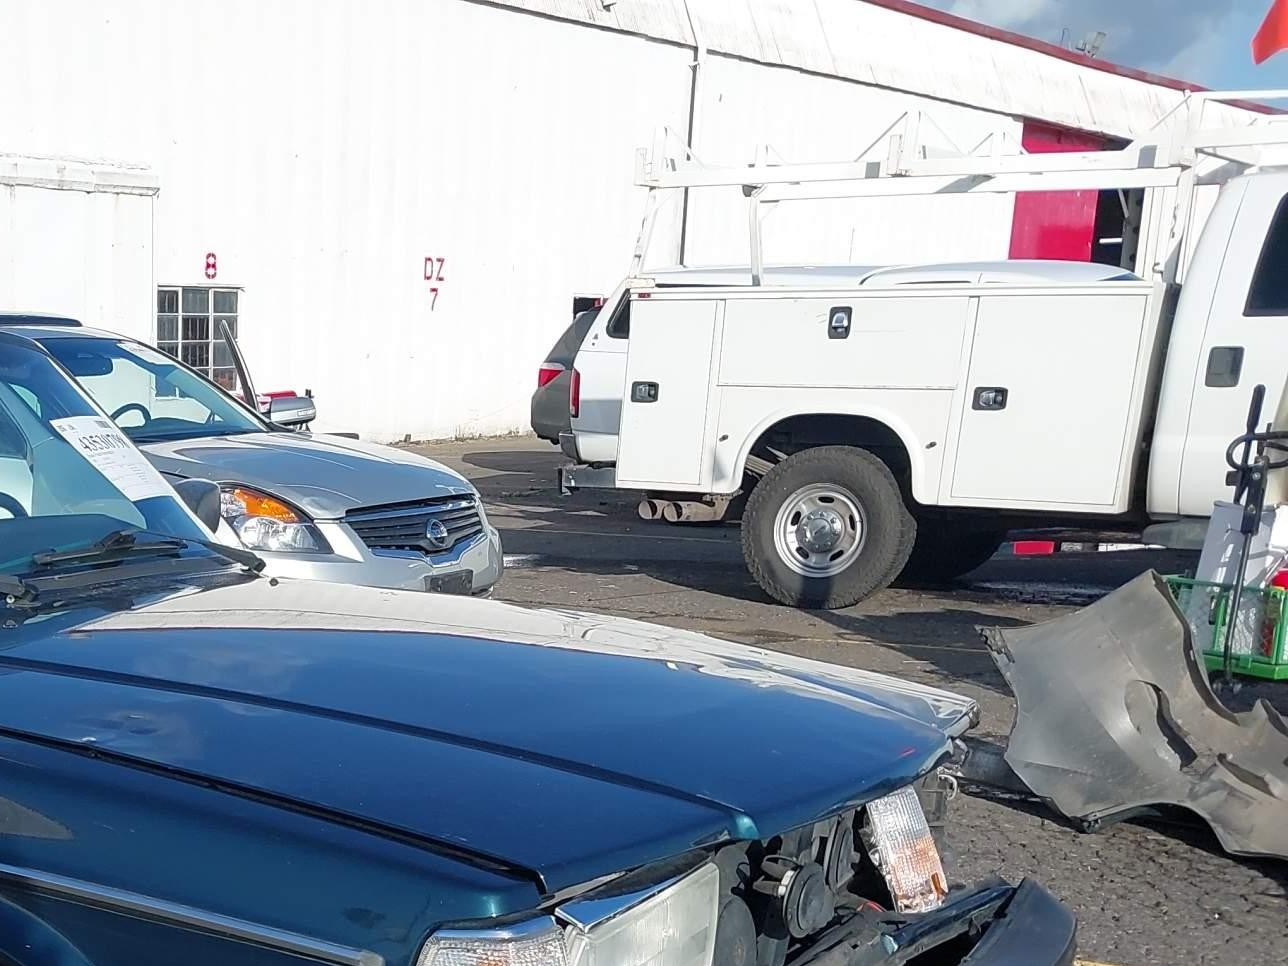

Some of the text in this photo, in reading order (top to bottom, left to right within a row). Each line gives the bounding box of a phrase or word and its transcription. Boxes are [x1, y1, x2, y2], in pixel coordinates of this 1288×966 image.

[205, 253, 216, 279] 8
[424, 257, 445, 281] DZ
[430, 288, 438, 311] 7
